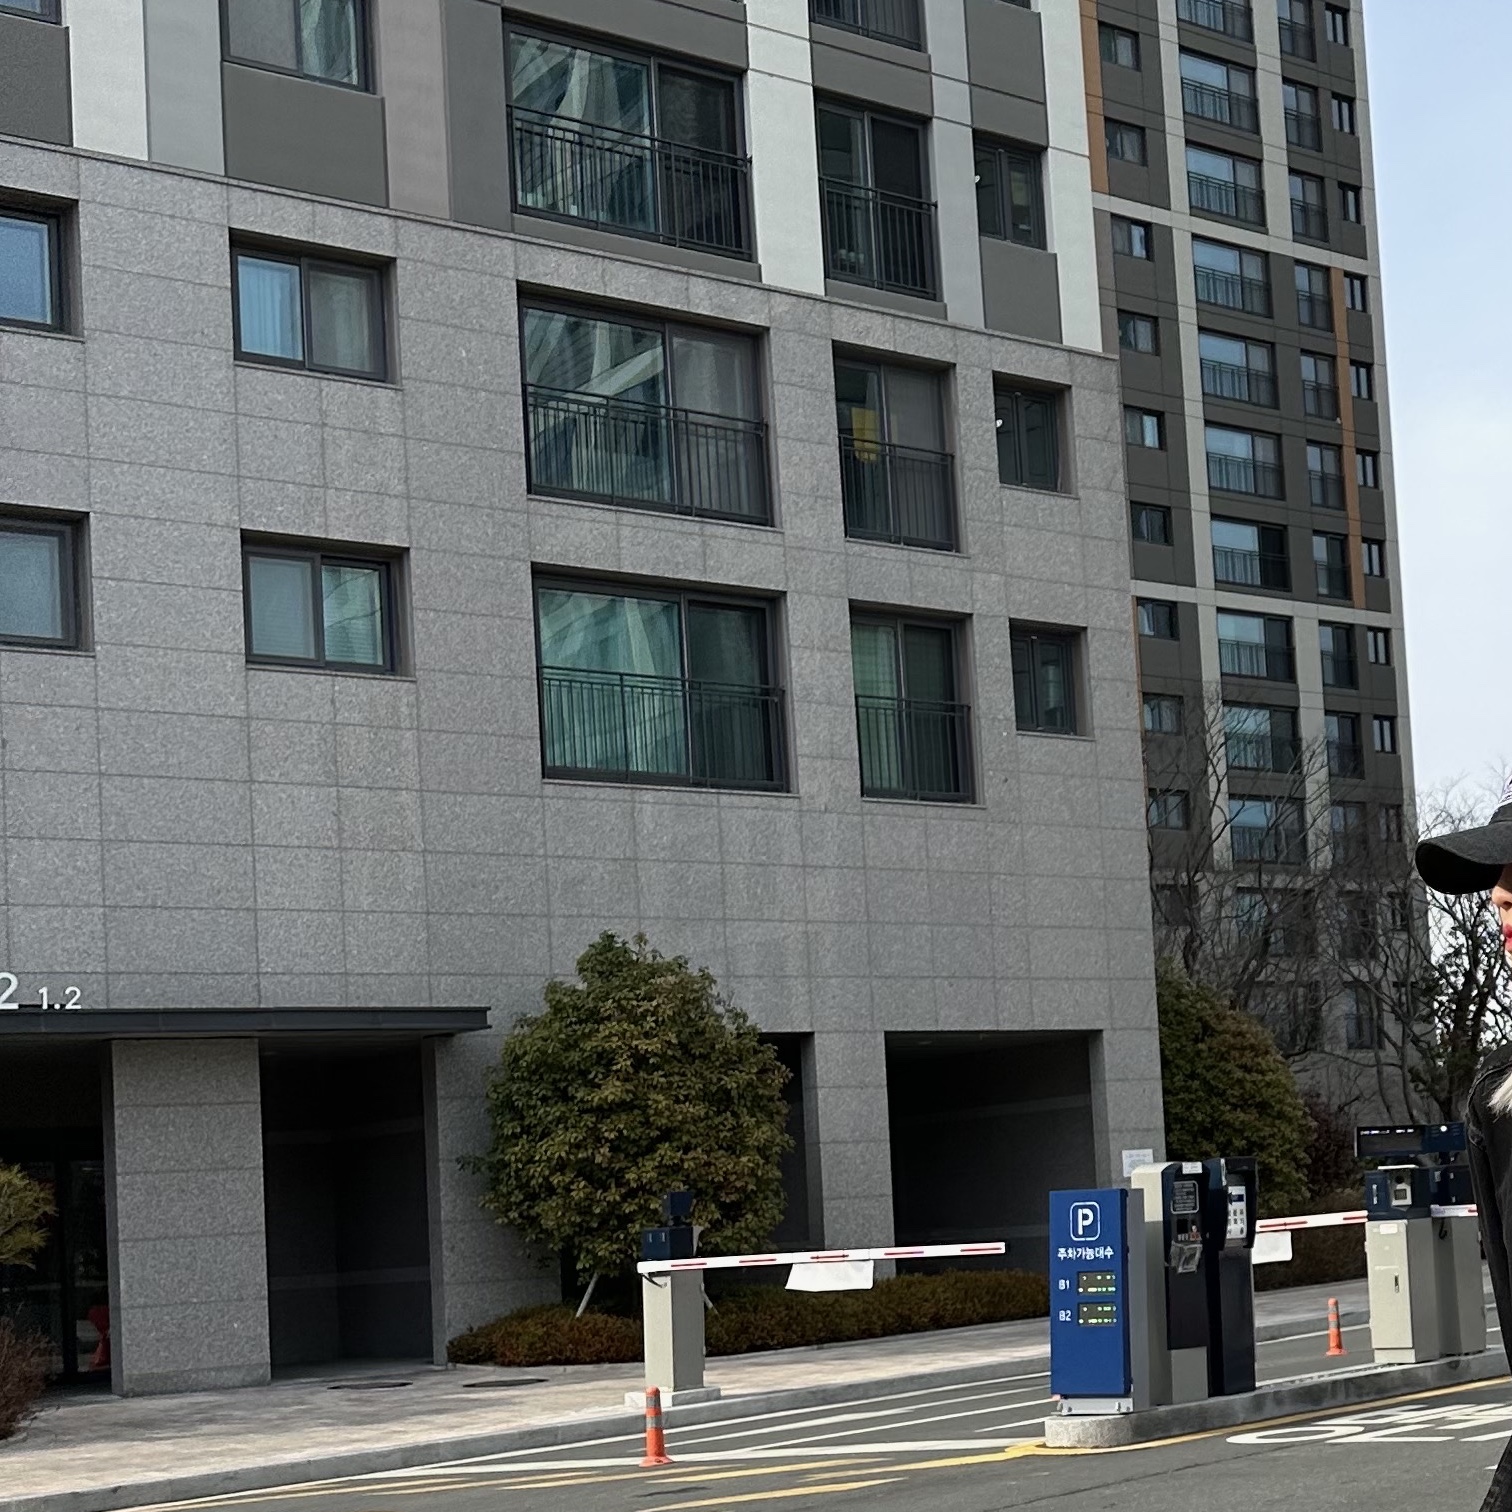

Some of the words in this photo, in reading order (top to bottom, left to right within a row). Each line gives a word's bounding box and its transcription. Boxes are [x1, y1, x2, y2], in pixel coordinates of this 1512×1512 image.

[38, 986, 82, 1010] 1.2
[1057, 1245, 1115, 1261] 주차가능대수
[1058, 1279, 1070, 1291] B1
[1058, 1309, 1072, 1322] B2
